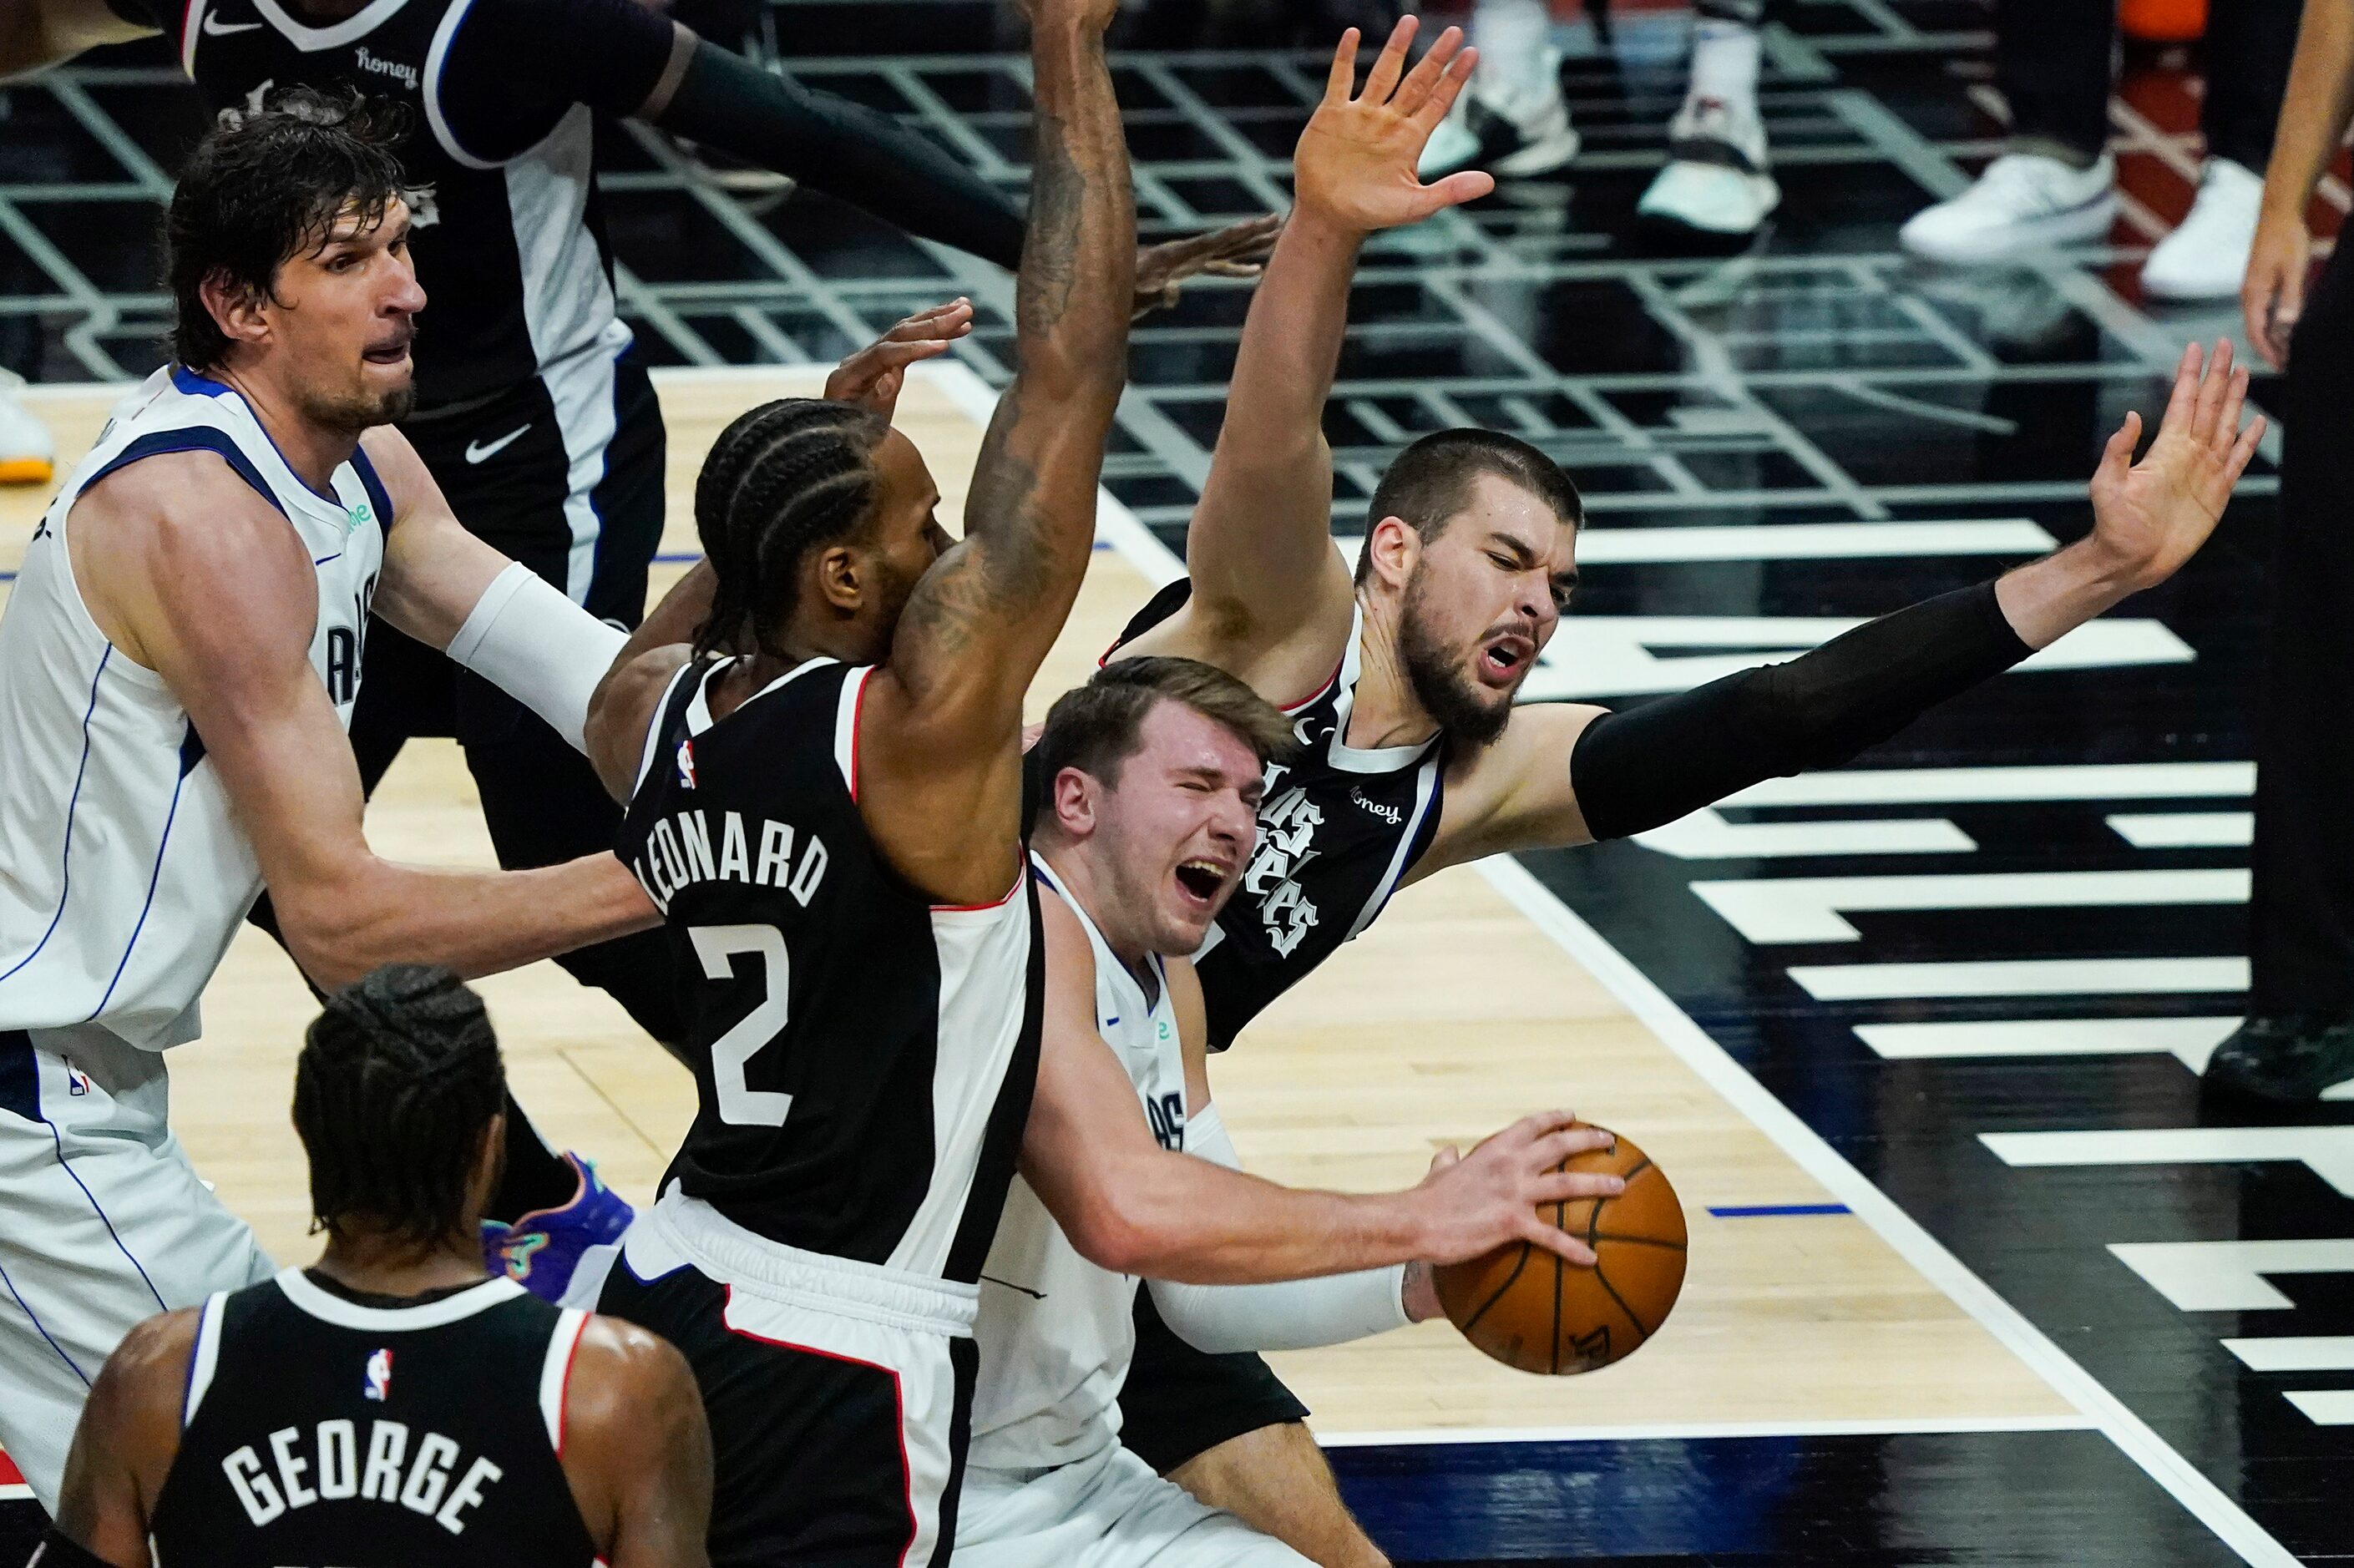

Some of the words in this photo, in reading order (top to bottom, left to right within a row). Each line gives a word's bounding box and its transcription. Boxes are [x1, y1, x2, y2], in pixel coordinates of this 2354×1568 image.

[354, 46, 418, 90] honey
[634, 809, 829, 916] LEONARD
[687, 923, 793, 1127] 2
[221, 1419, 503, 1535] GEORGE
